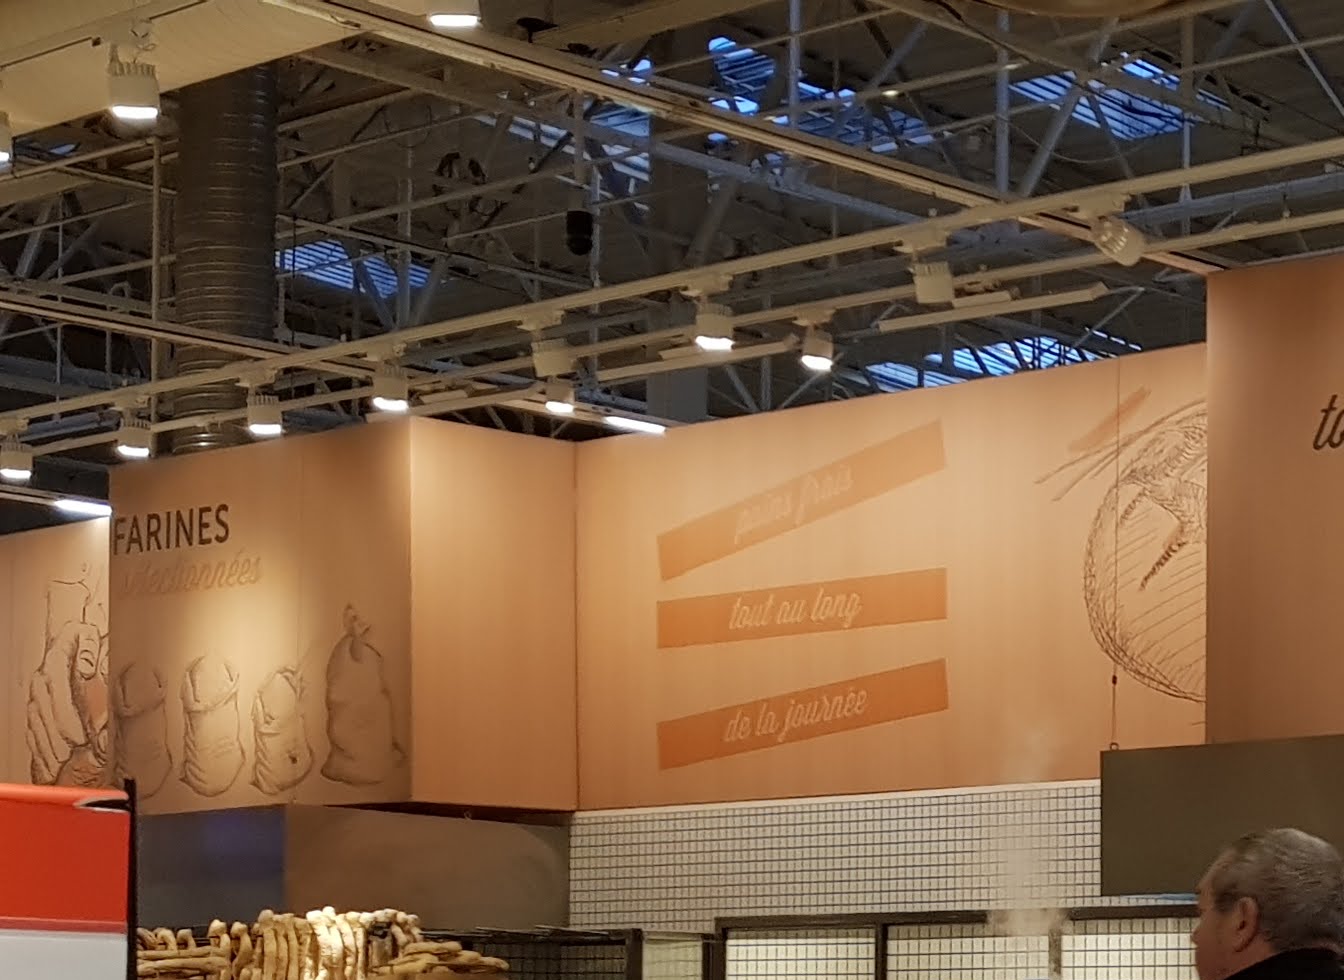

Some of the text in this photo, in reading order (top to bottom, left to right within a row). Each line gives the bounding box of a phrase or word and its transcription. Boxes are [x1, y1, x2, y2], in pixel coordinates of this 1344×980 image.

[114, 503, 230, 556] FARINES
[728, 588, 863, 631] tout au long
[724, 689, 869, 744] de la journée
